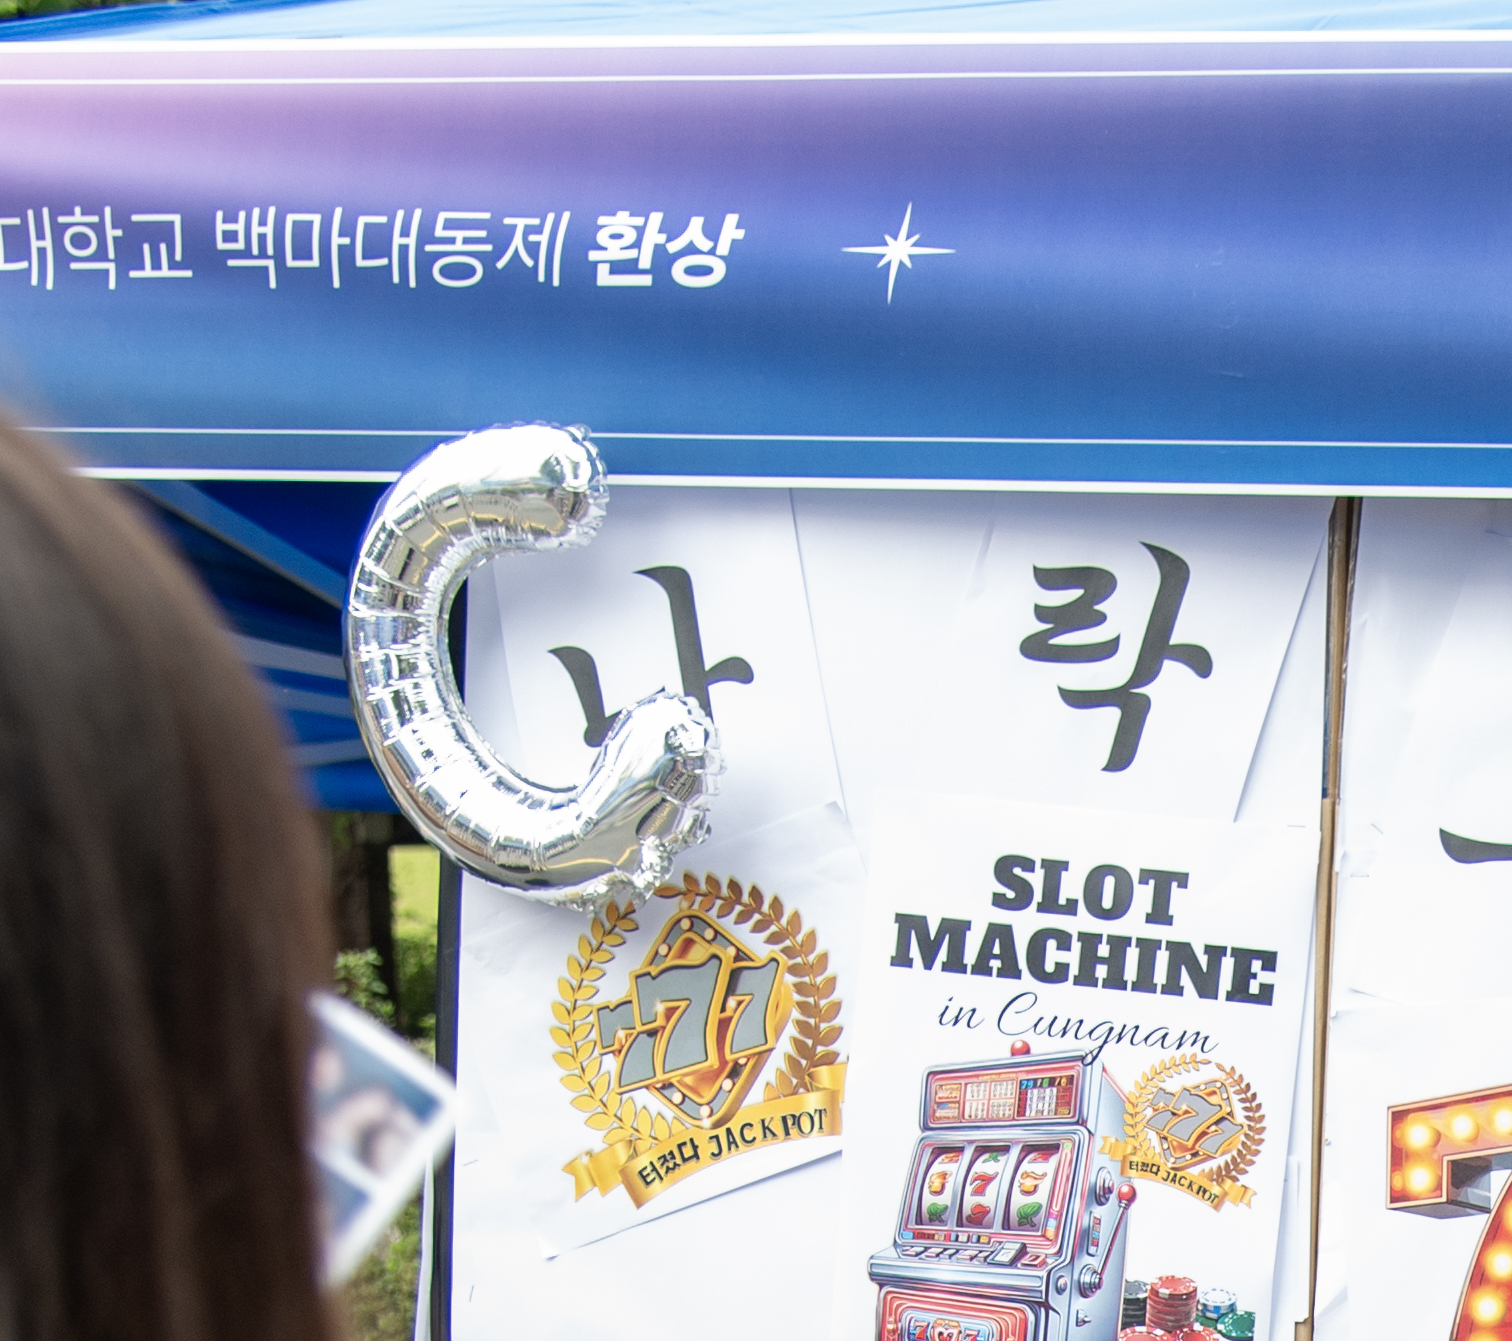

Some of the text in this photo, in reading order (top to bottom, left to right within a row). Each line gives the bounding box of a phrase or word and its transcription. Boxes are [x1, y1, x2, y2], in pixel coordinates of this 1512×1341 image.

[214, 205, 571, 289] 백마대동제
[586, 209, 746, 289] 환상
[991, 854, 1189, 927] SLOT
[889, 912, 1278, 1007] MACHINE
[937, 990, 1220, 1067] in Cungnam
[637, 1107, 828, 1189] 터졌다 JACKPOT
[1161, 1169, 1220, 1205] JACKPOT
